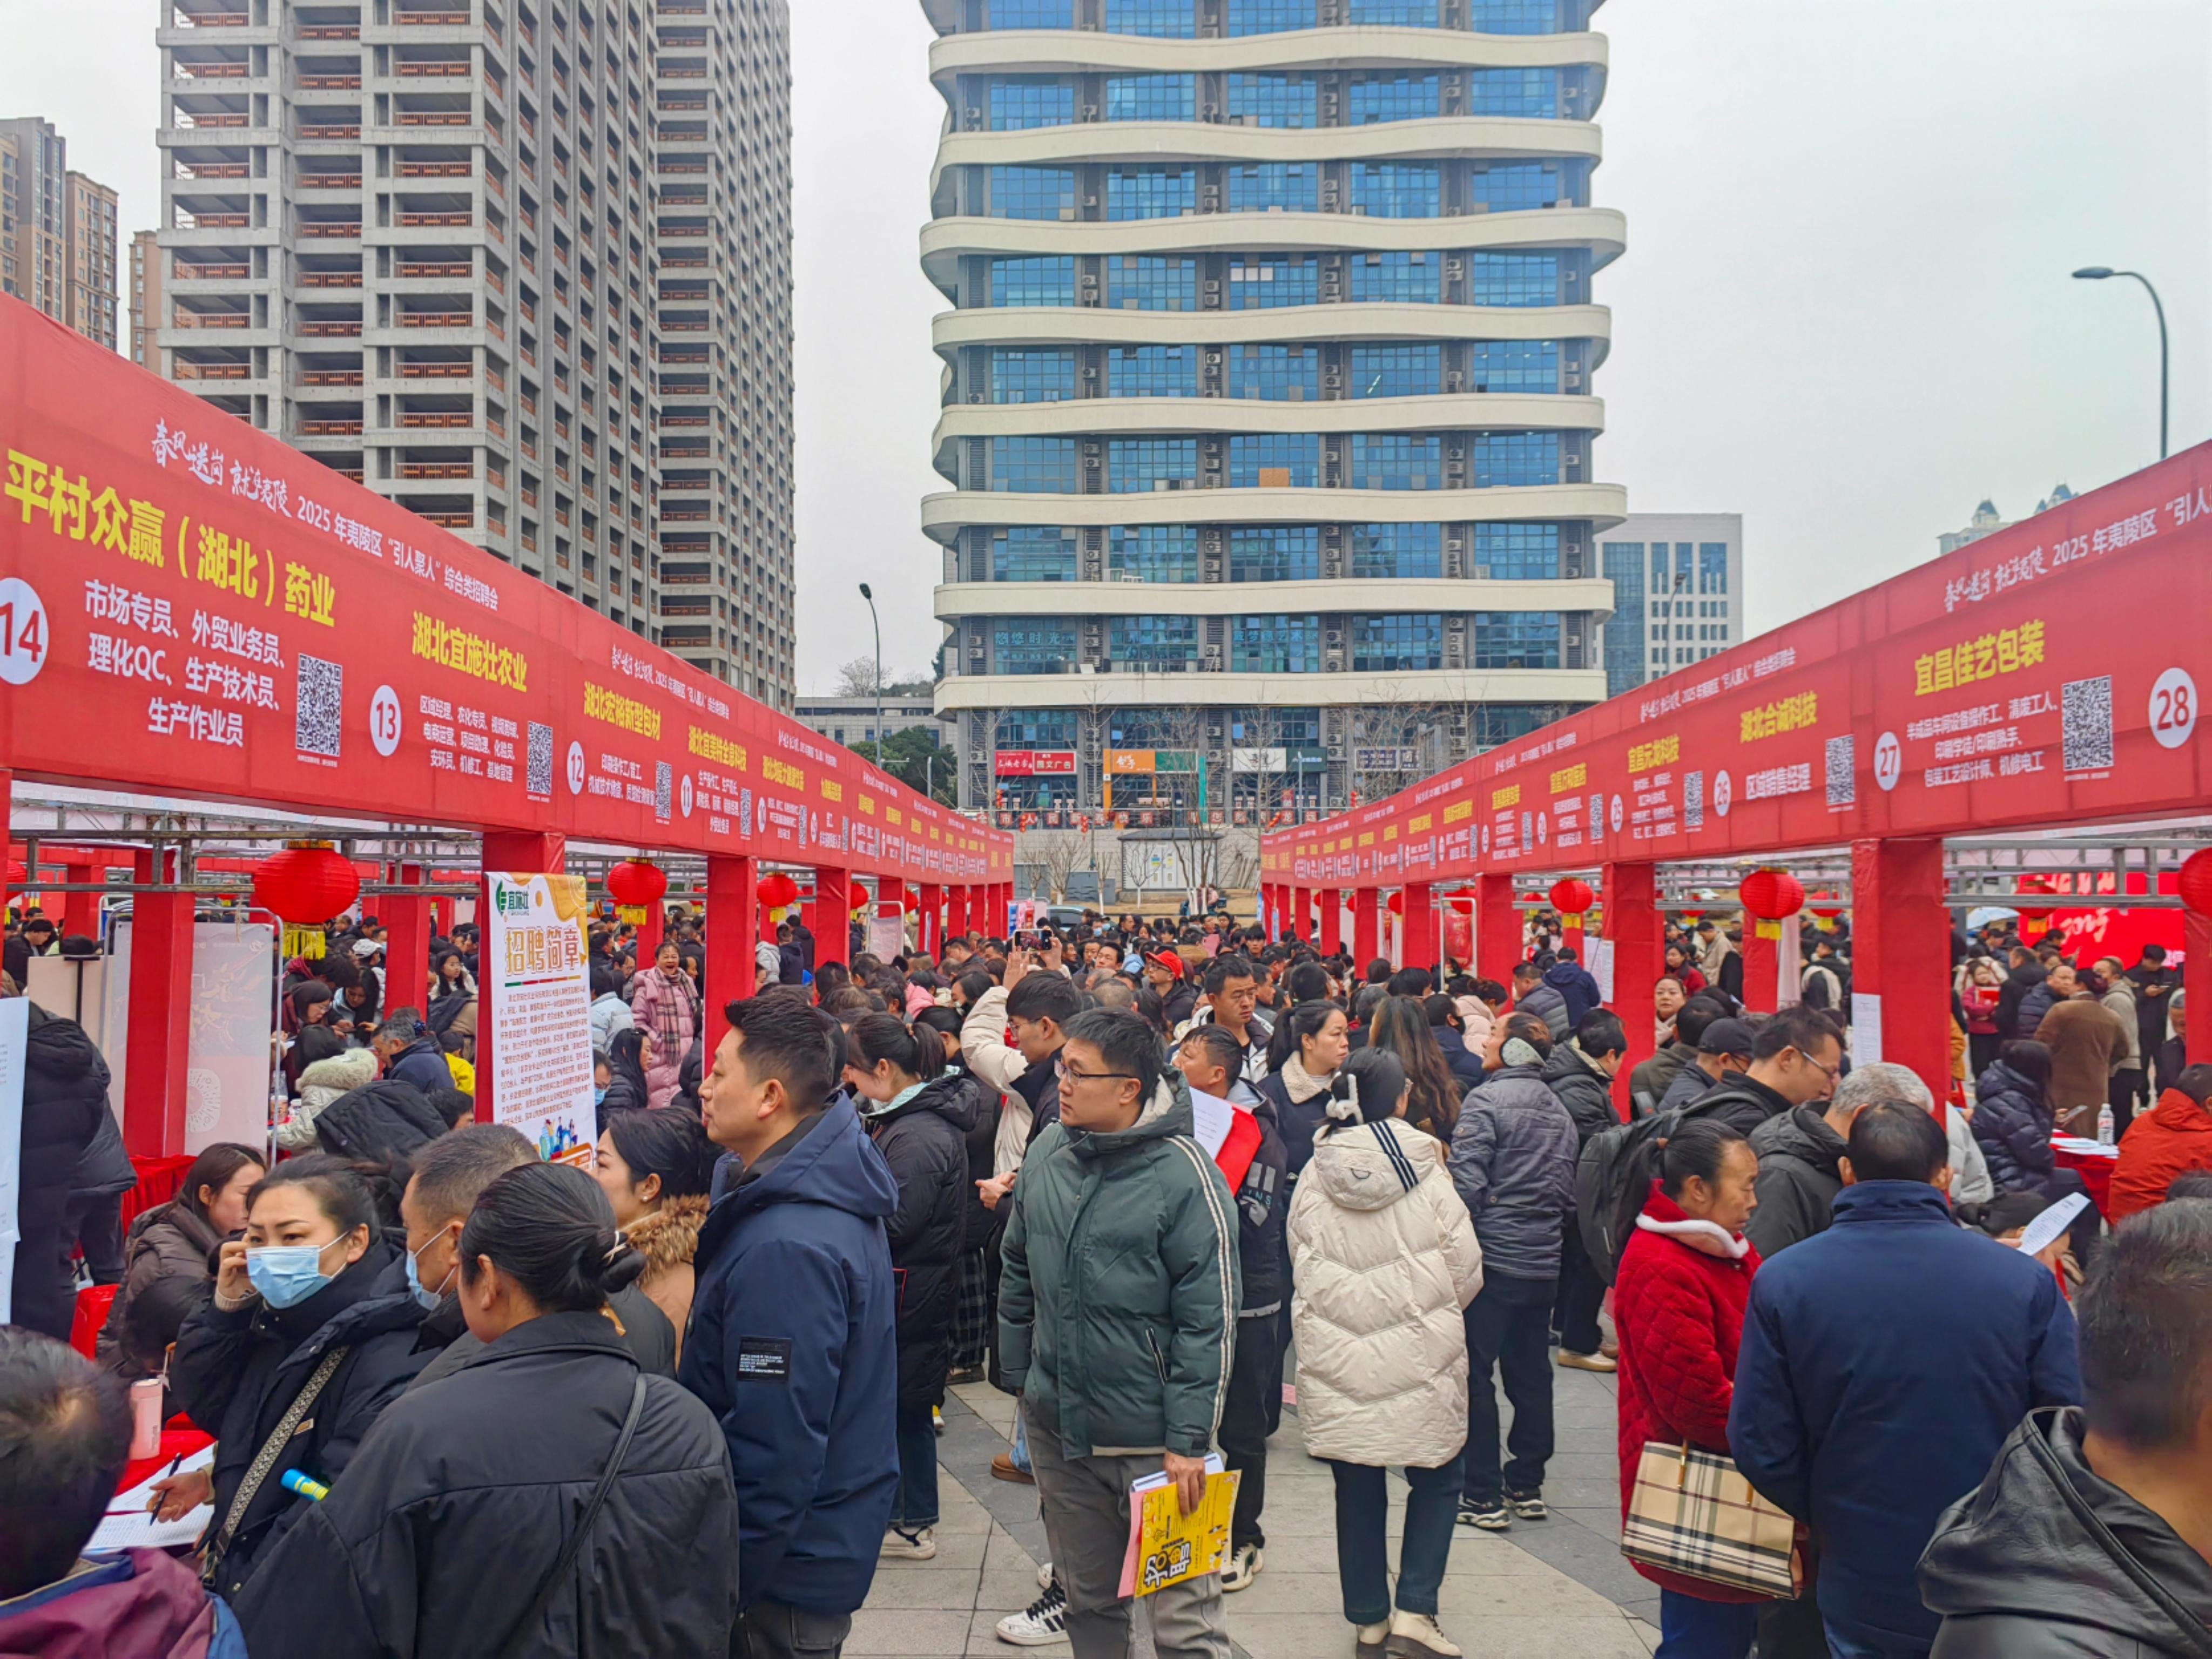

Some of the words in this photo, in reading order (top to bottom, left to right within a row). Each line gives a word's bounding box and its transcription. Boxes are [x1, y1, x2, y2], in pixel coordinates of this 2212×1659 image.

[298, 496, 331, 532] 2025
[334, 512, 383, 558] 年夷陵区
[2053, 535, 2088, 567] 2025
[2092, 508, 2158, 555] 年夷陵区
[0, 601, 42, 664] 14
[412, 610, 527, 692] 湖北宜施壮农业
[1914, 618, 2045, 696] 宜昌佳艺包装
[148, 697, 243, 747] 生产作业员
[376, 700, 396, 740] 13
[2156, 685, 2189, 732] 28
[571, 753, 583, 783] 12
[1880, 744, 1897, 777] 27
[1717, 780, 1728, 806] 26
[506, 927, 579, 975] 招聘简章
